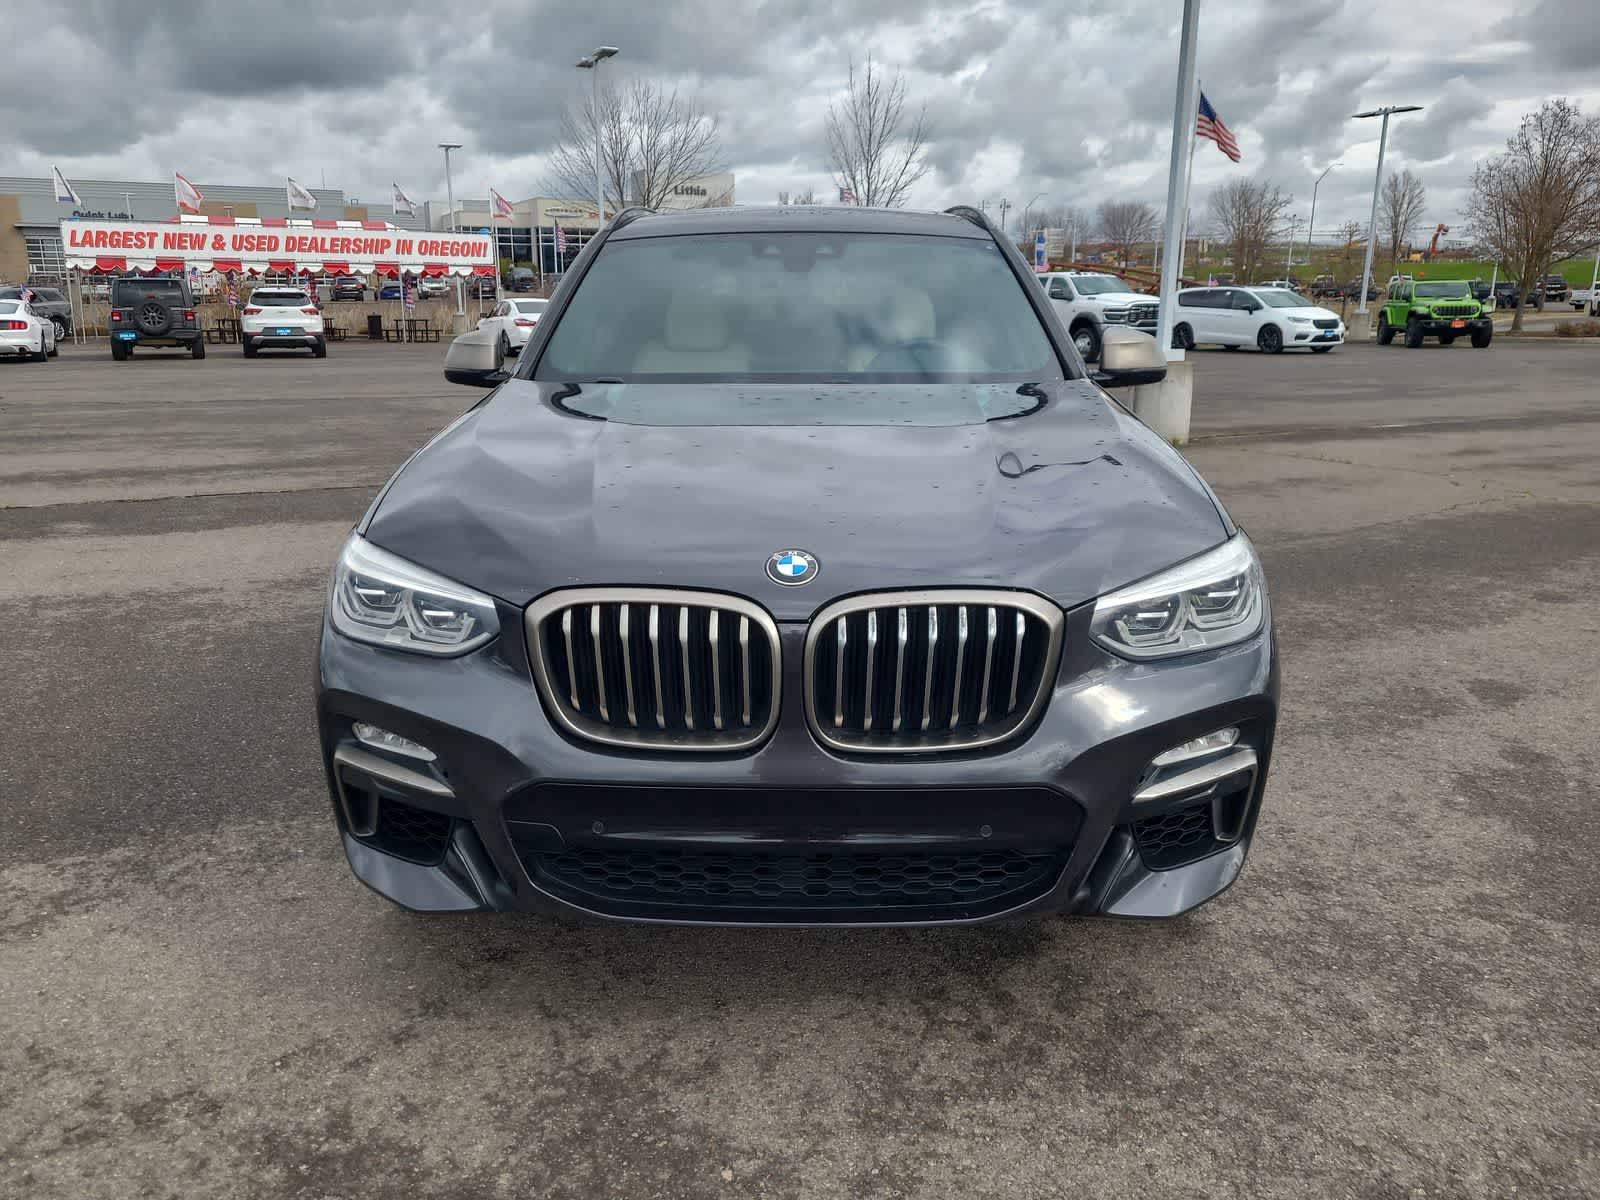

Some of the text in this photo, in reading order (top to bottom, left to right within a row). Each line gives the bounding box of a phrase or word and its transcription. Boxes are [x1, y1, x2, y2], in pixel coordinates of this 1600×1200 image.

[673, 184, 707, 196] Lithia
[70, 230, 488, 257] LARGEST NEW & USED DEALERSHIP IN OREGON!
